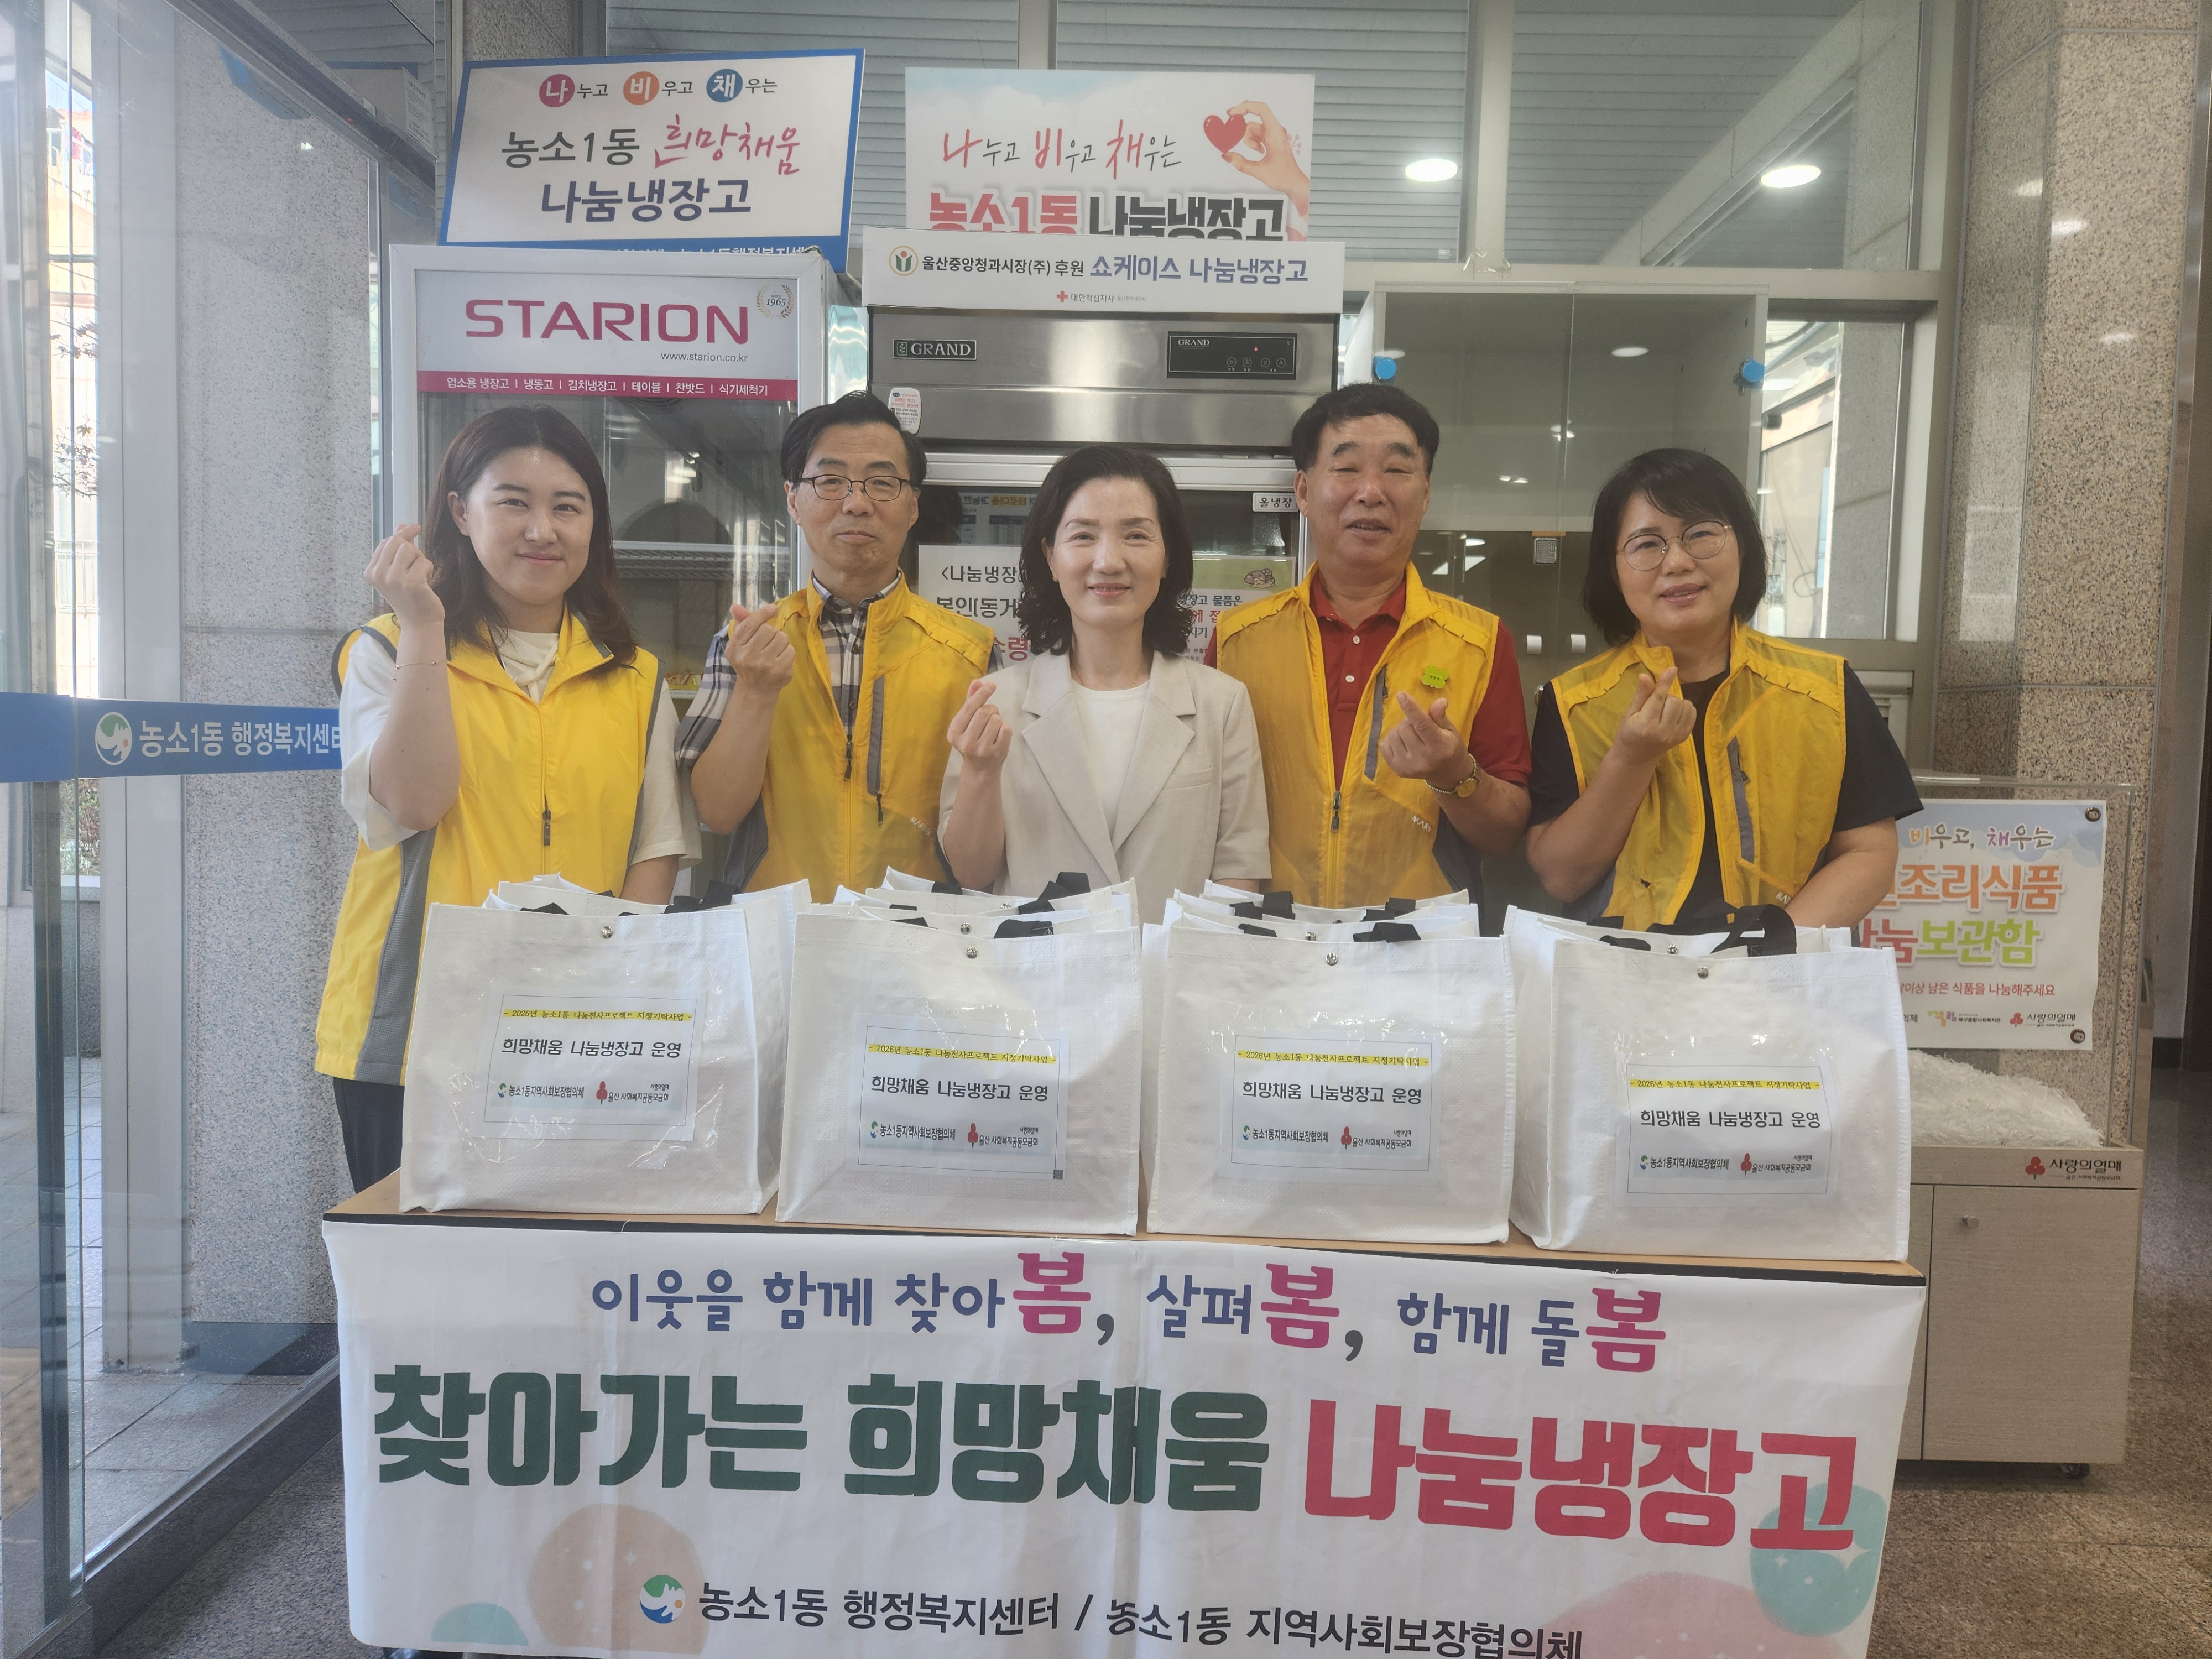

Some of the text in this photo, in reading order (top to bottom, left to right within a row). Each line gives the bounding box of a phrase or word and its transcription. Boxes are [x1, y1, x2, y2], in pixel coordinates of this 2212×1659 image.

[545, 74, 776, 103] 나누고 비우고 채우는
[502, 114, 801, 175] 농소1동 희망채움
[943, 119, 1182, 180] 나누고 비우고 채우는
[541, 178, 752, 223] 나눔냉장고
[930, 192, 1286, 242] 농소1동 나눔냉장고
[922, 254, 1308, 286] 울산중앙청과시장(주) 후원 쇼케이스 나눔냉장고
[766, 298, 786, 307] 1965
[1071, 293, 1115, 303] 대한적십자사
[466, 299, 749, 345] STARION
[660, 352, 748, 363] www.starion.co.kr
[911, 343, 971, 356] GRAND
[447, 377, 768, 396] 업소용 냉장고 냉동고 김치냉장고 테이블 찬밧드 식기세척기
[1213, 596, 1243, 607] 물품은
[139, 720, 224, 758] 농소1동
[1910, 823, 2055, 851] 비우고, 채우는
[1928, 983, 1949, 995] 남은
[1953, 983, 1985, 995] 식품을
[1989, 983, 2056, 997] 나눔해주세요
[512, 1010, 538, 1018] 2026년
[573, 1011, 633, 1020] 나눔천사프로젝트
[637, 1012, 684, 1021] 지정기탁사업
[502, 1039, 682, 1058] 희망채움 나눔냉장고 운영
[877, 1045, 901, 1055] 2026년
[905, 1047, 932, 1056] 농소1동
[936, 1050, 998, 1061] 나눔천사프로젝트
[1246, 1051, 1271, 1061] 2026년
[1275, 1053, 1302, 1061] 농소1동
[508, 1085, 585, 1098] 농소1동지역사회보장협의체
[871, 1076, 1048, 1101] 희망채움 나눔냉장고 운영
[1242, 1081, 1422, 1104] 희망채움 나눔냉장고 운영
[1637, 1079, 1663, 1088] 2026년
[1766, 1081, 1811, 1090] 지정기탁사업
[1640, 1110, 1821, 1128] 희망채움 나눔냉장고 운영
[880, 1124, 956, 1141] 농소1동지역사회보장협의체
[1252, 1128, 1329, 1142] 농소1동지역사회보장협의체
[1650, 1157, 1729, 1170] 농소1동지역사회보장협의체
[2049, 1159, 2121, 1174] 사랑의열매
[592, 1252, 1666, 1373] 이웃을 함께 찾아봄, 살펴봄, 함께 돌봄
[374, 1364, 1858, 1551] 찾아가는 희망채움 나눔냉장고
[699, 1580, 828, 1627] 농소1동
[844, 1589, 1059, 1636] 행정복지센터
[1107, 1599, 1231, 1646] 농소1동
[1246, 1605, 1583, 1659] 지역사회보장협의체
